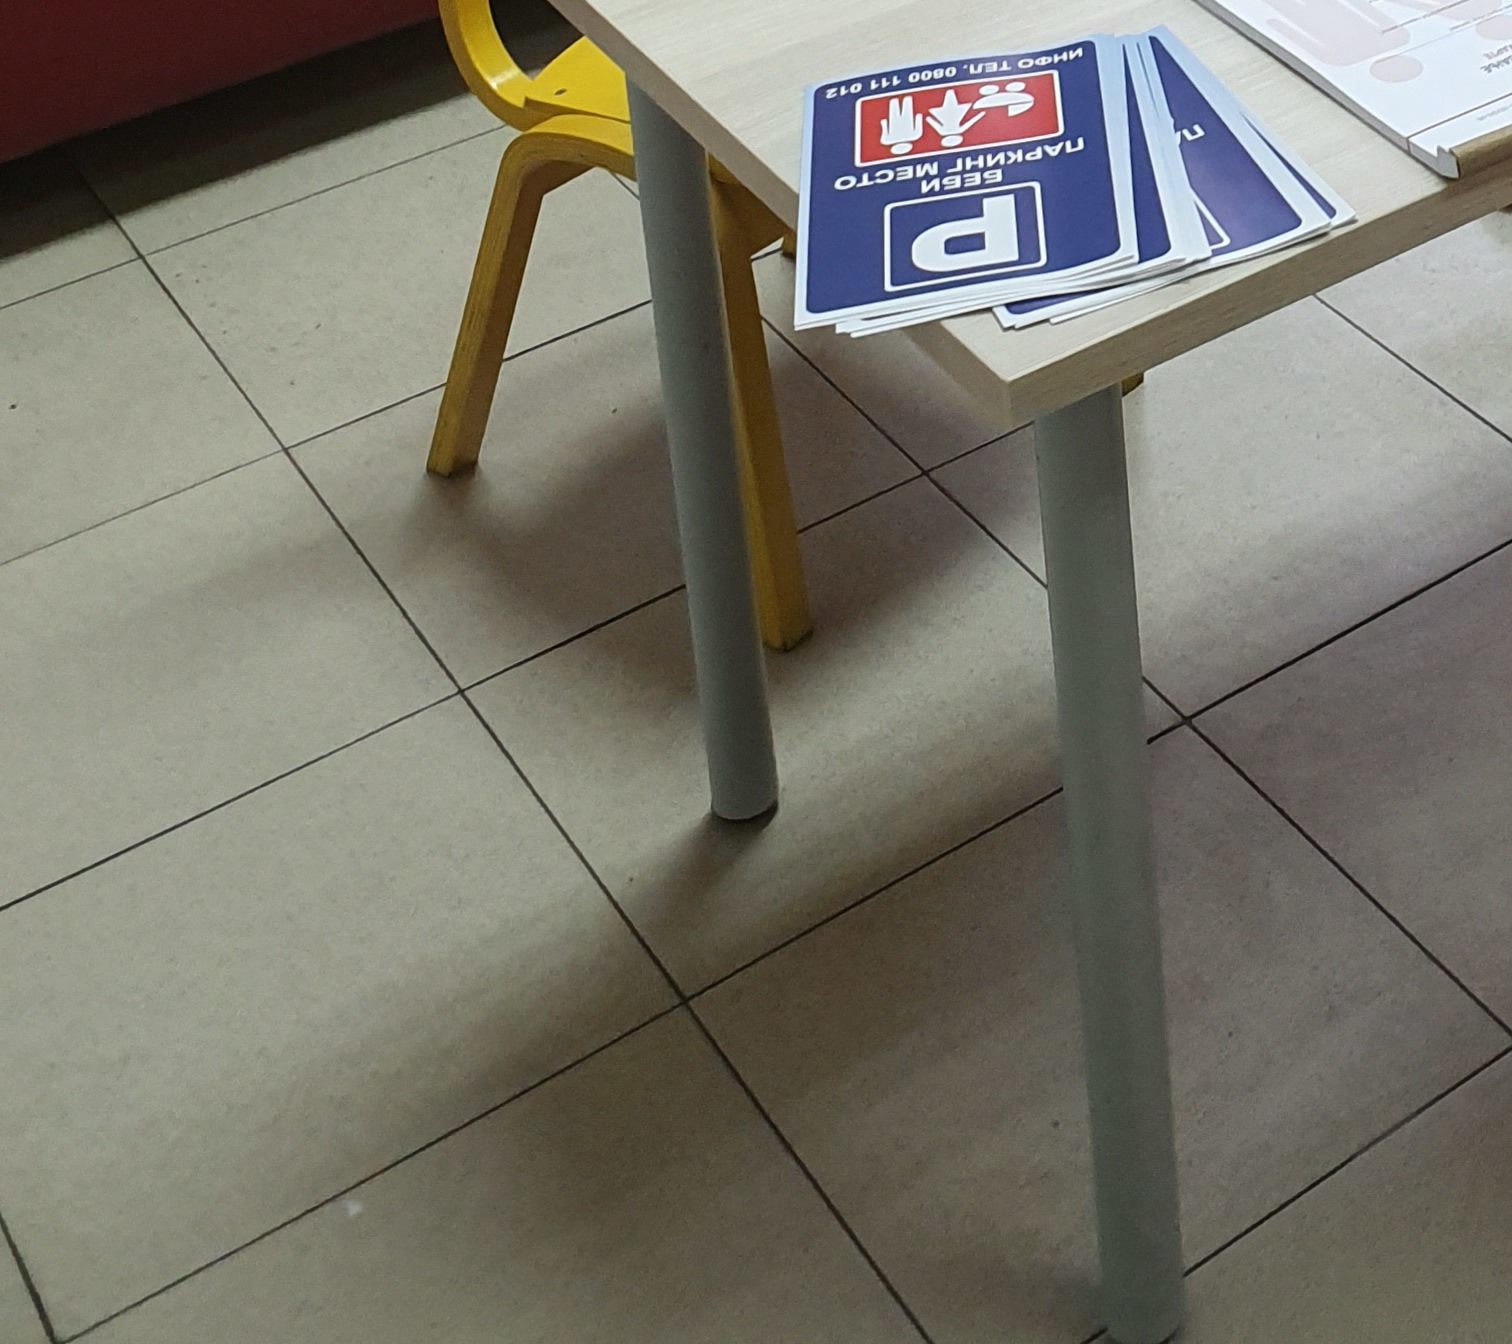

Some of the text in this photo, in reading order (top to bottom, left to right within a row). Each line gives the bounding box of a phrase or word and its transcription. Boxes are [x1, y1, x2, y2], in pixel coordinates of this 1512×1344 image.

[825, 47, 1084, 99] ИНФО ТЕЛ. 0800 111 012
[833, 137, 1085, 191] ПАРКИНГ МЕСТО
[919, 169, 1004, 194] БЕБИ
[911, 193, 1020, 273] P
